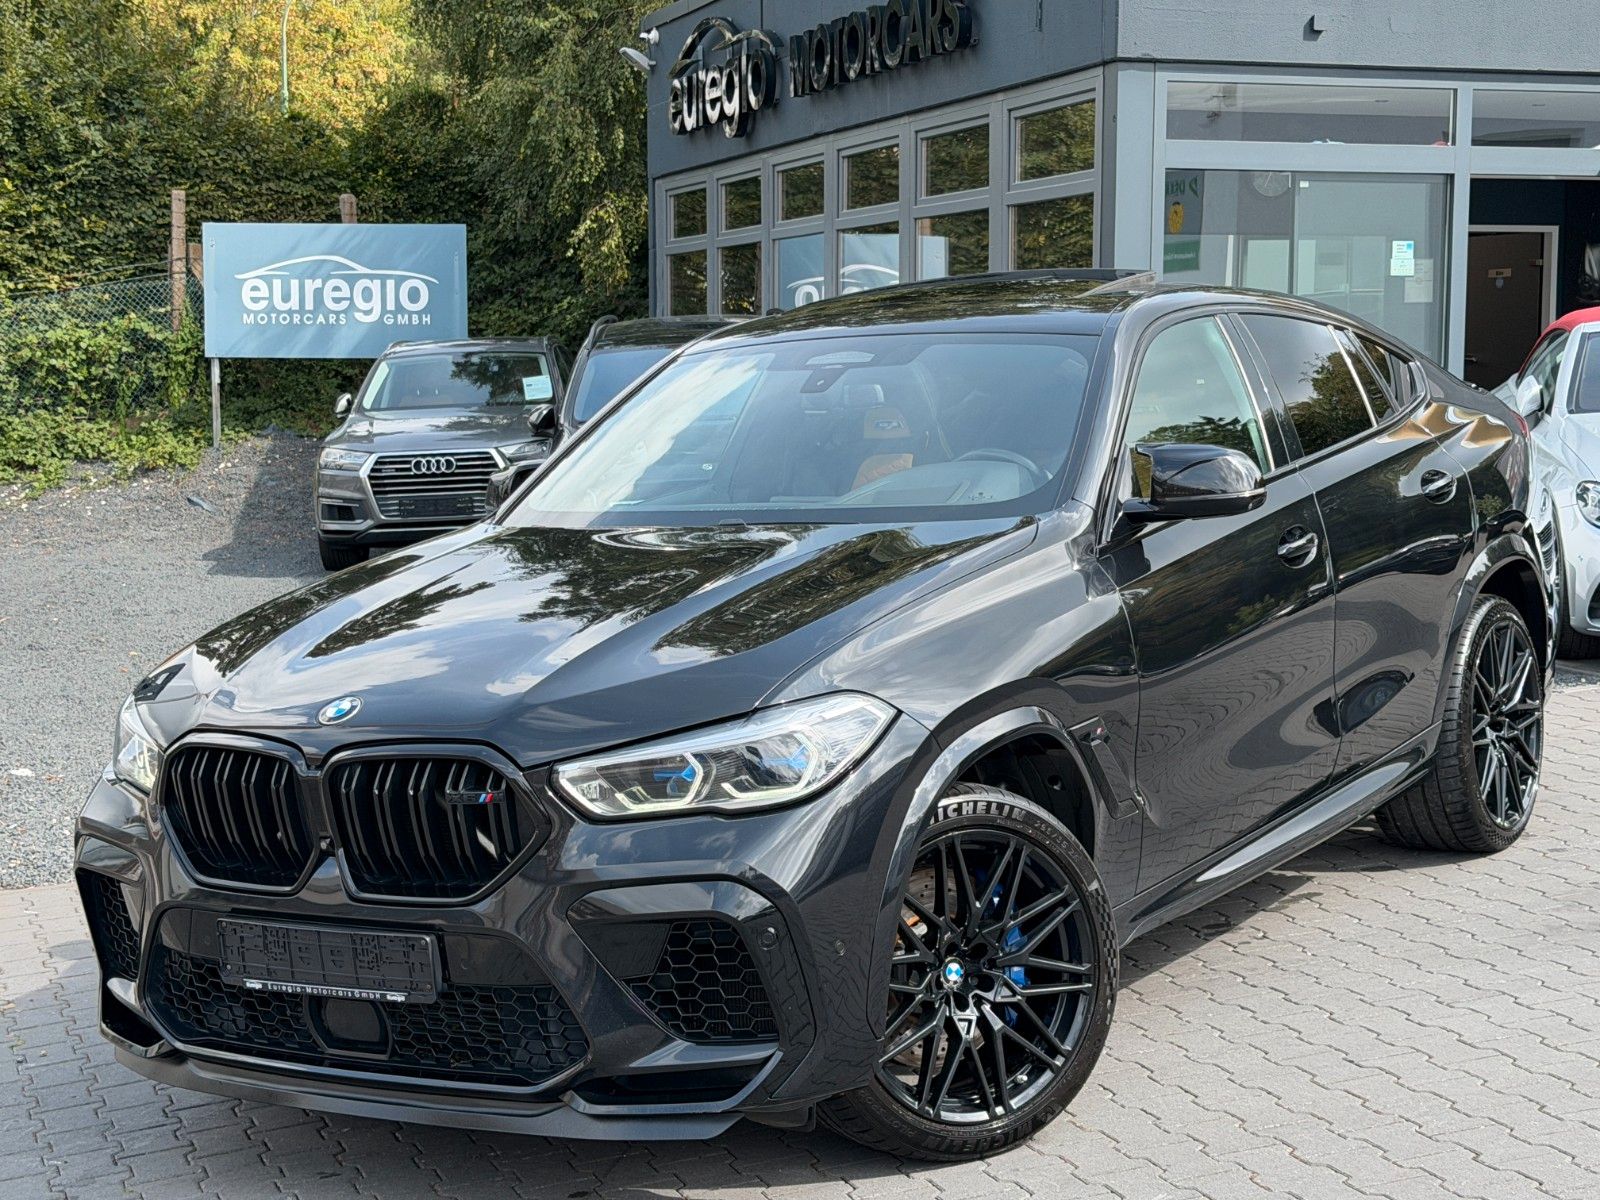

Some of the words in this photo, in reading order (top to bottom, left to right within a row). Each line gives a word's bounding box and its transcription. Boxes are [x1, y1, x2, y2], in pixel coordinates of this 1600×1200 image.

[668, 50, 775, 139] euregio
[789, 0, 972, 97] MOTORCARS
[241, 278, 429, 322] euregio
[242, 313, 347, 324] MOTORCARS
[383, 313, 431, 324] GMBH
